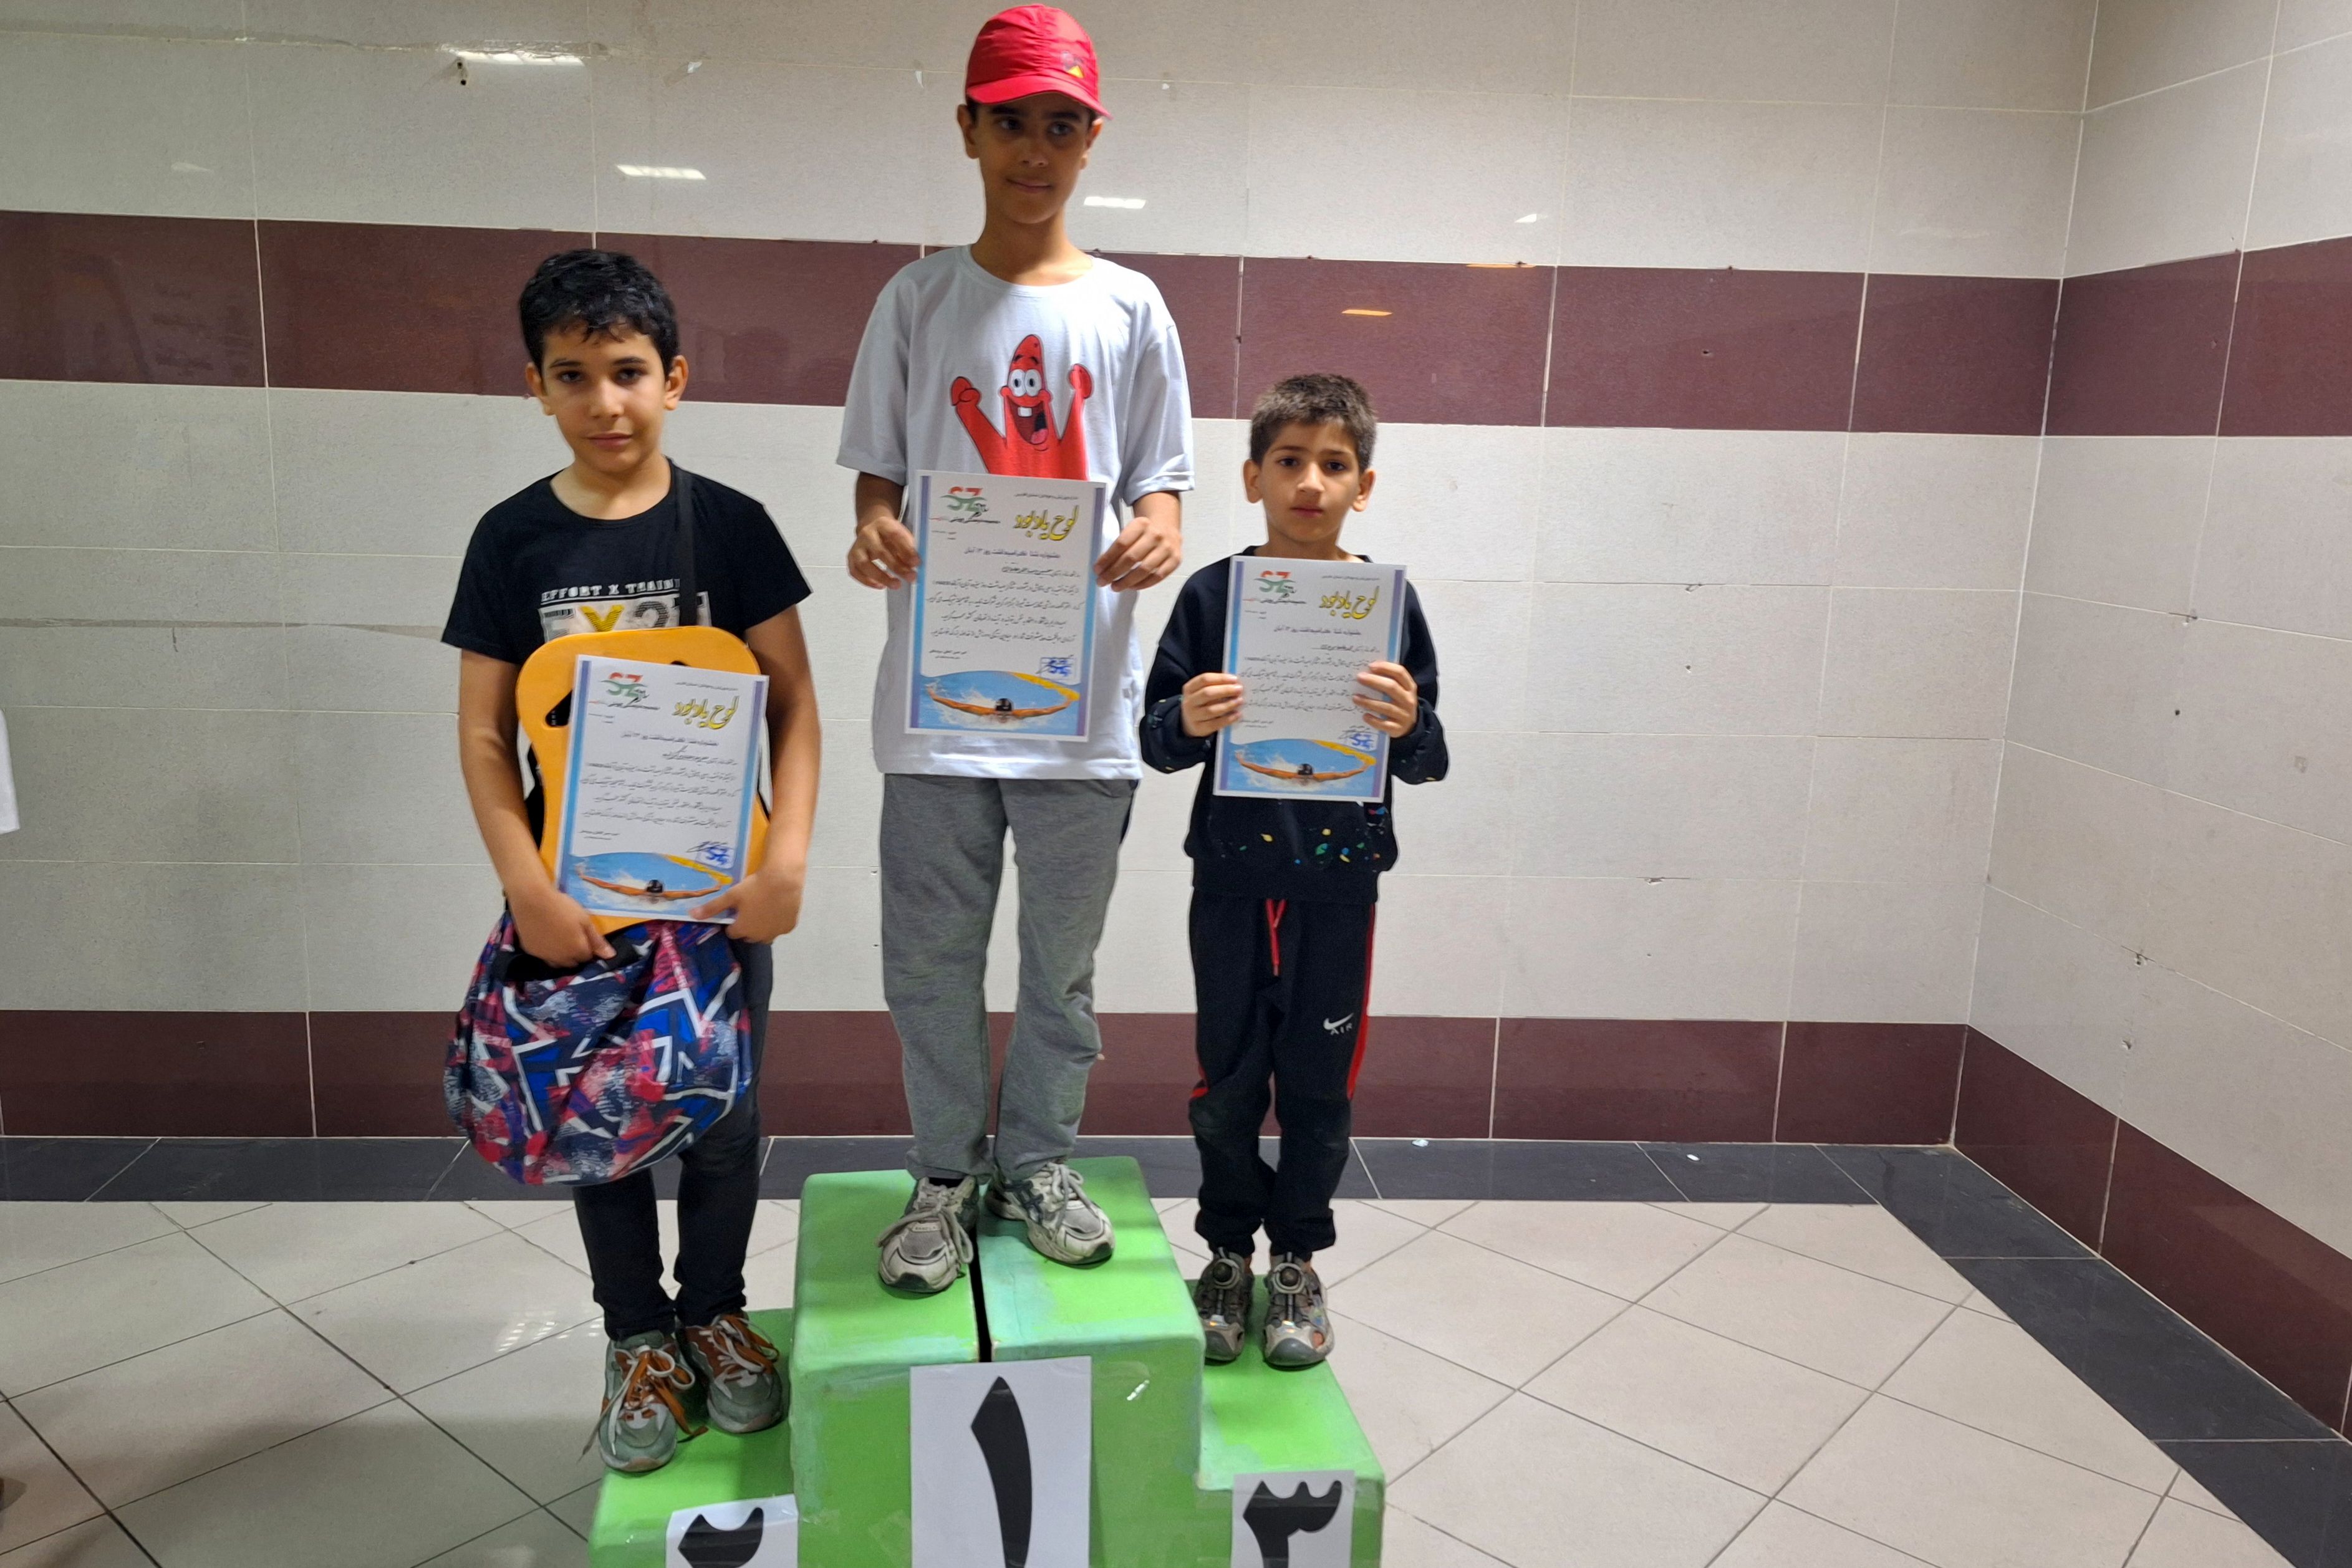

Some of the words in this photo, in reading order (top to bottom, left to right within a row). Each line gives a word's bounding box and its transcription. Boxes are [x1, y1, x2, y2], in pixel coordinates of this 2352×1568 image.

[1013, 509, 1048, 540] یادبود
[1049, 505, 1079, 541] لوح
[541, 585, 602, 602] EFFORT
[609, 584, 619, 595] X
[1319, 590, 1351, 618] یادبود
[1352, 585, 1379, 619] لوح
[672, 698, 707, 728] یادبود
[707, 696, 740, 729] لوح
[1331, 1022, 1352, 1035] AIR
[971, 1376, 1032, 1568] ۱
